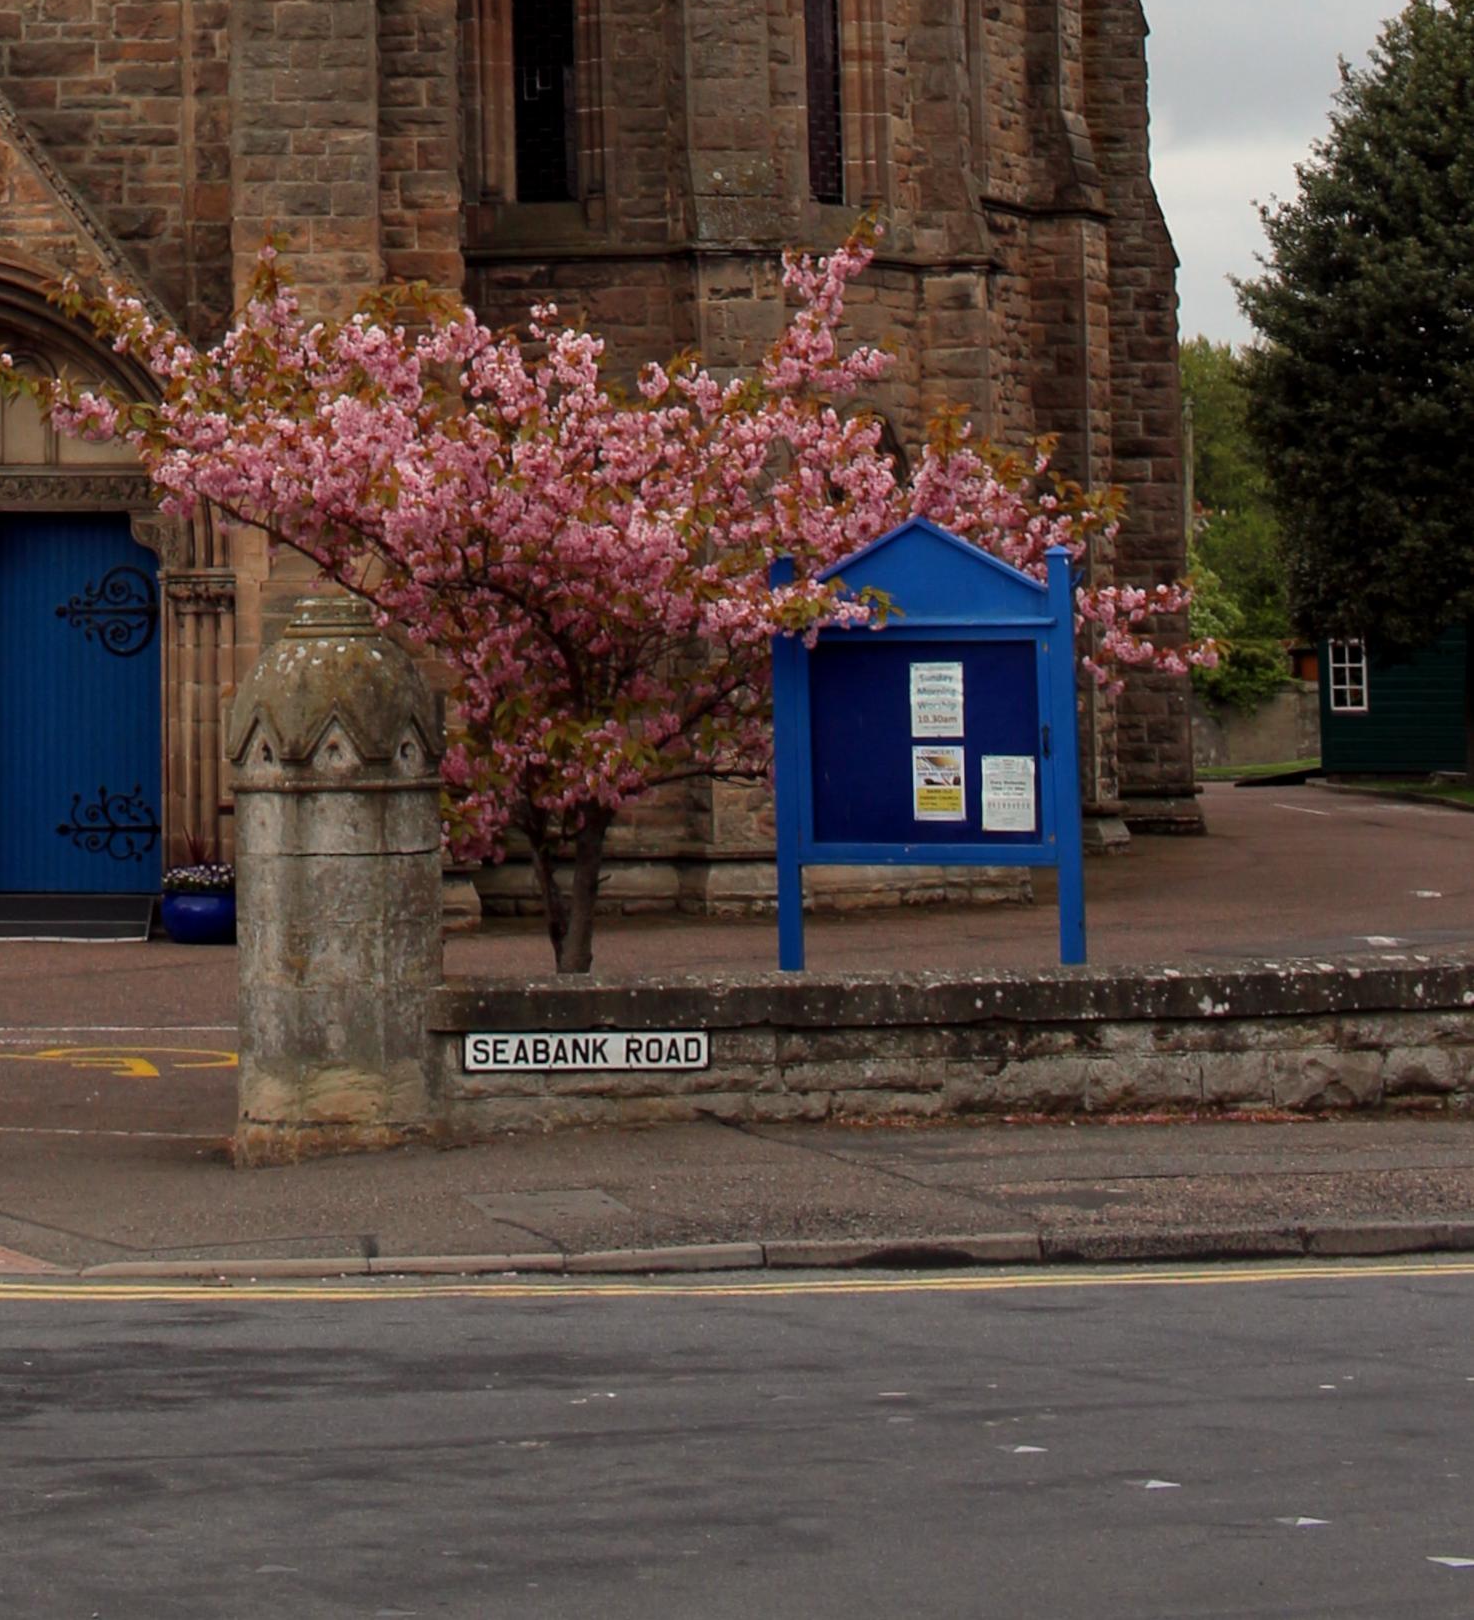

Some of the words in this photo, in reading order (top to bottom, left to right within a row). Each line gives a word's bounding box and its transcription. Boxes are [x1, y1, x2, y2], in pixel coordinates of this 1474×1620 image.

[919, 672, 954, 683] Sunday
[917, 686, 957, 698] Morning
[917, 700, 957, 711] Worship
[918, 714, 958, 724] 10.30am
[472, 1038, 609, 1065] SEABANK
[624, 1037, 702, 1064] ROAD
